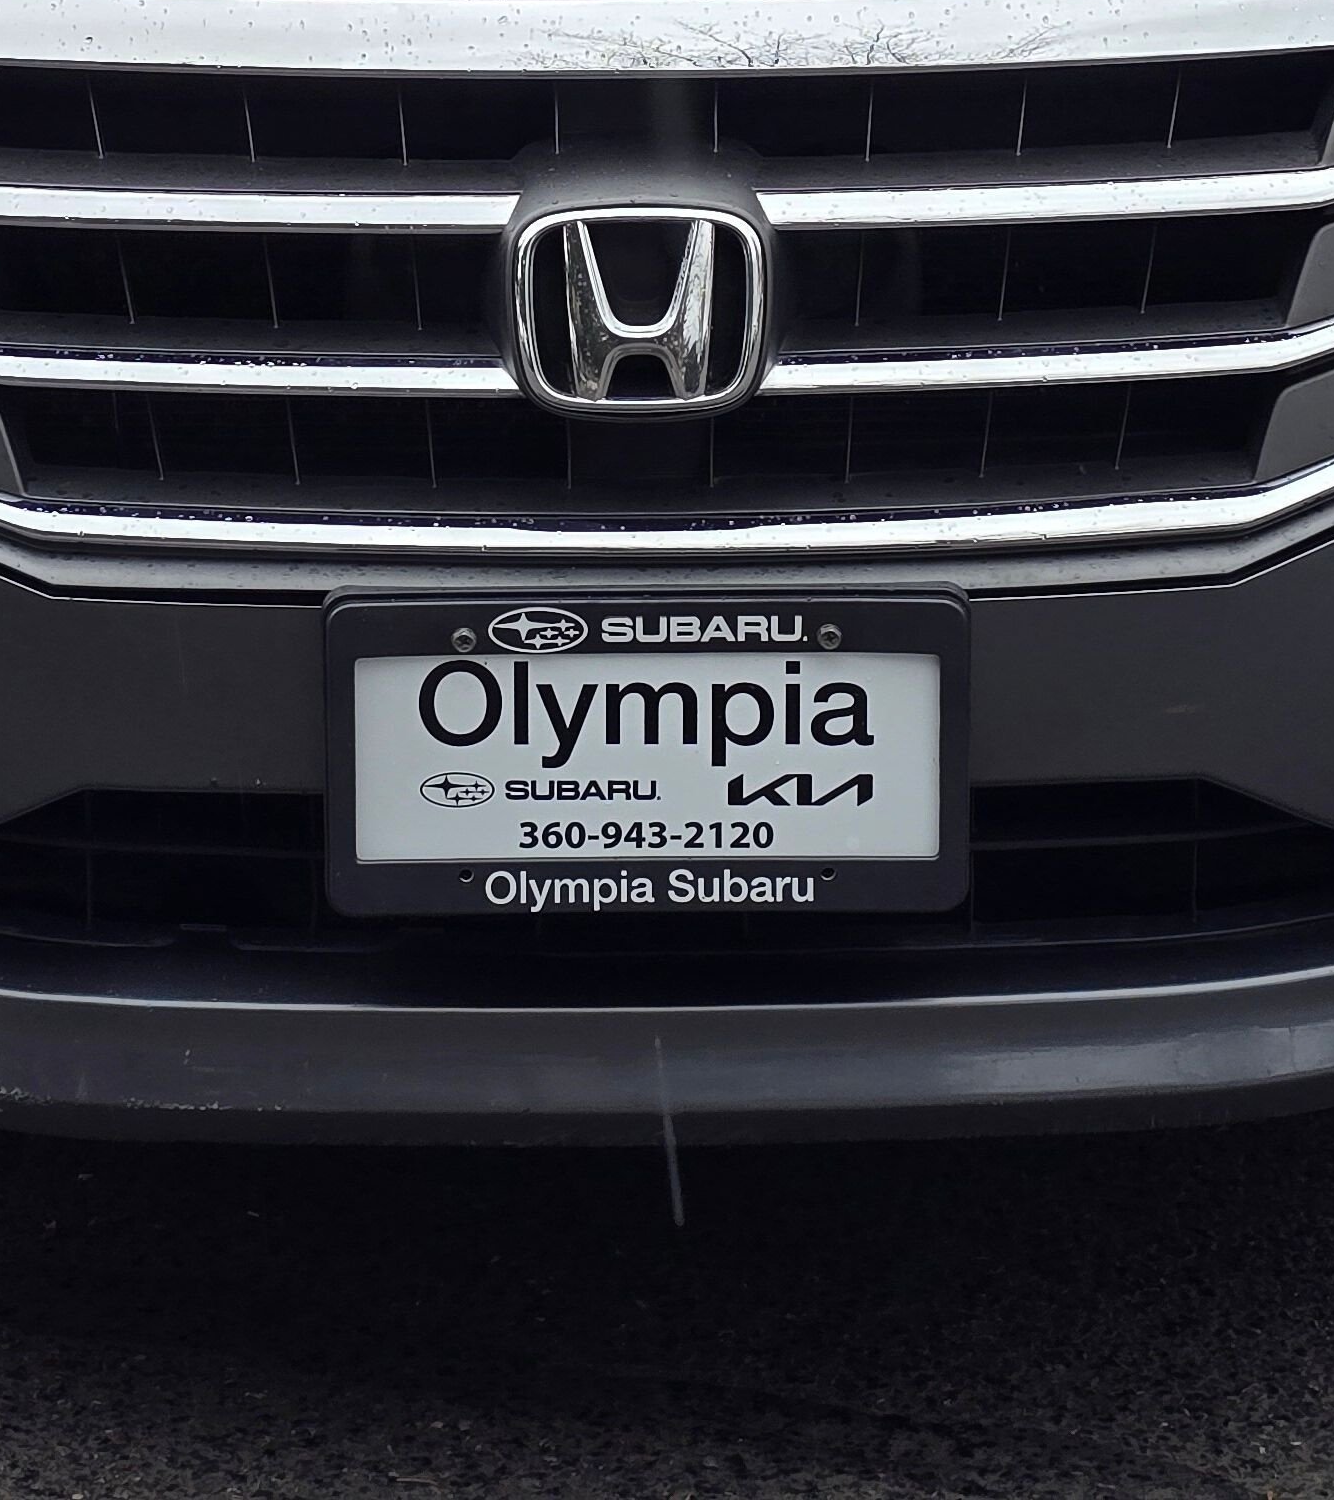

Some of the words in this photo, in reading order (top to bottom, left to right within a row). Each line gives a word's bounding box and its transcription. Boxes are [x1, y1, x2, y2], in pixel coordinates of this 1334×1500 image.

[418, 659, 875, 768] Olympia
[518, 821, 774, 849] 360-943-2120
[484, 869, 655, 912] Olympia
[667, 868, 815, 903] Subaru
